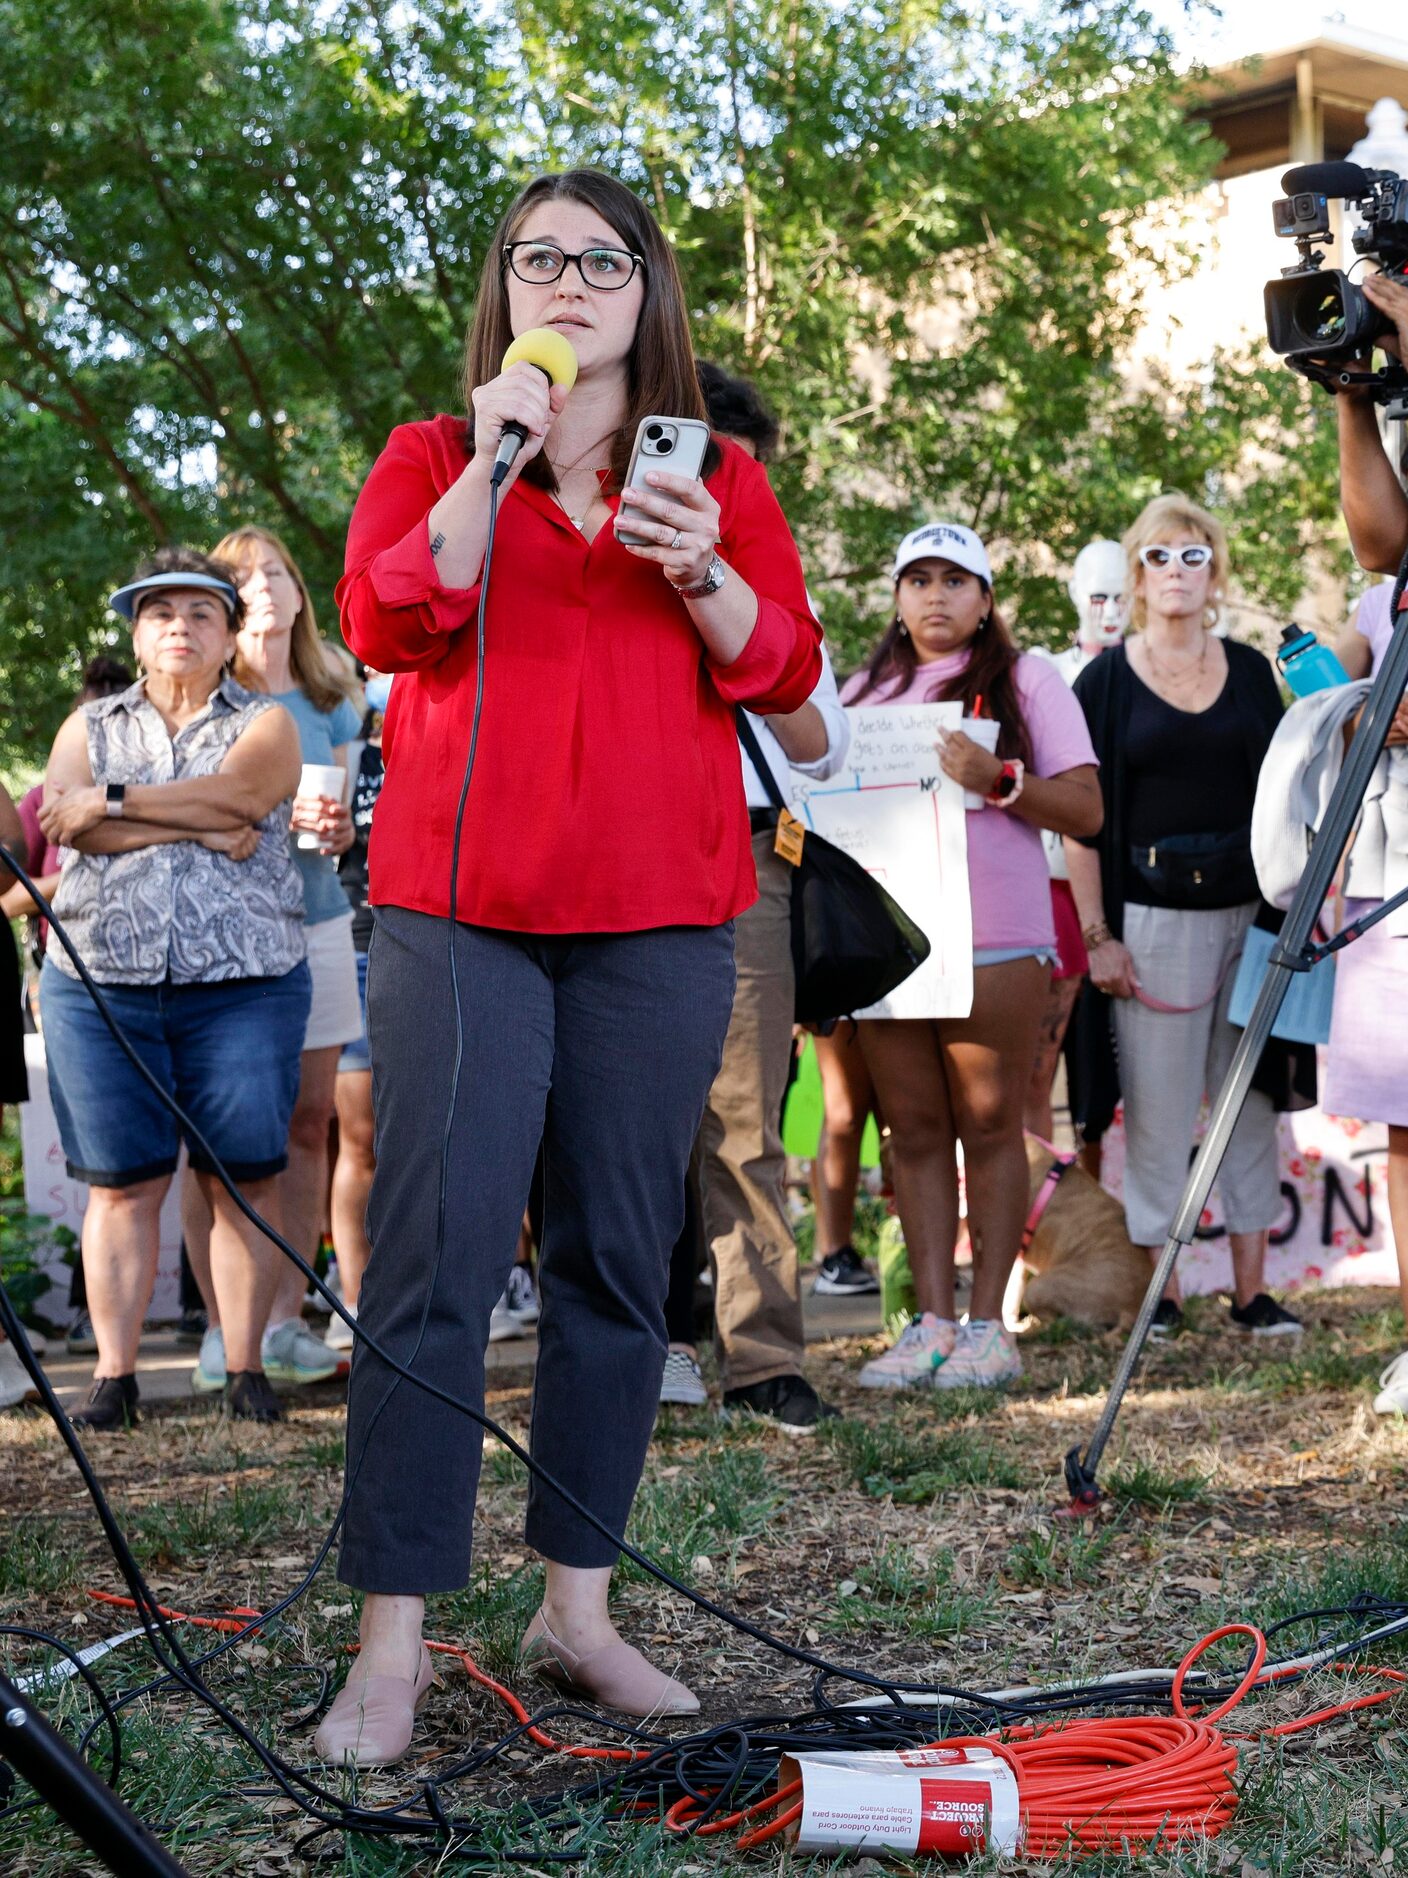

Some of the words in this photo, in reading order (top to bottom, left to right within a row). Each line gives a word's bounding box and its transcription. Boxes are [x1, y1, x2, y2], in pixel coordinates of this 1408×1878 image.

[920, 776, 942, 793] NO
[859, 1805, 885, 1813] liviano
[886, 1806, 913, 1815] trabajo
[831, 1812, 870, 1820] exteriores
[890, 1816, 913, 1824] Cable
[930, 1811, 985, 1823] PROJECT
[818, 1822, 838, 1830] Cord
[839, 1823, 871, 1832] Outdoor
[872, 1824, 890, 1833] Duty
[892, 1826, 912, 1834] Light
